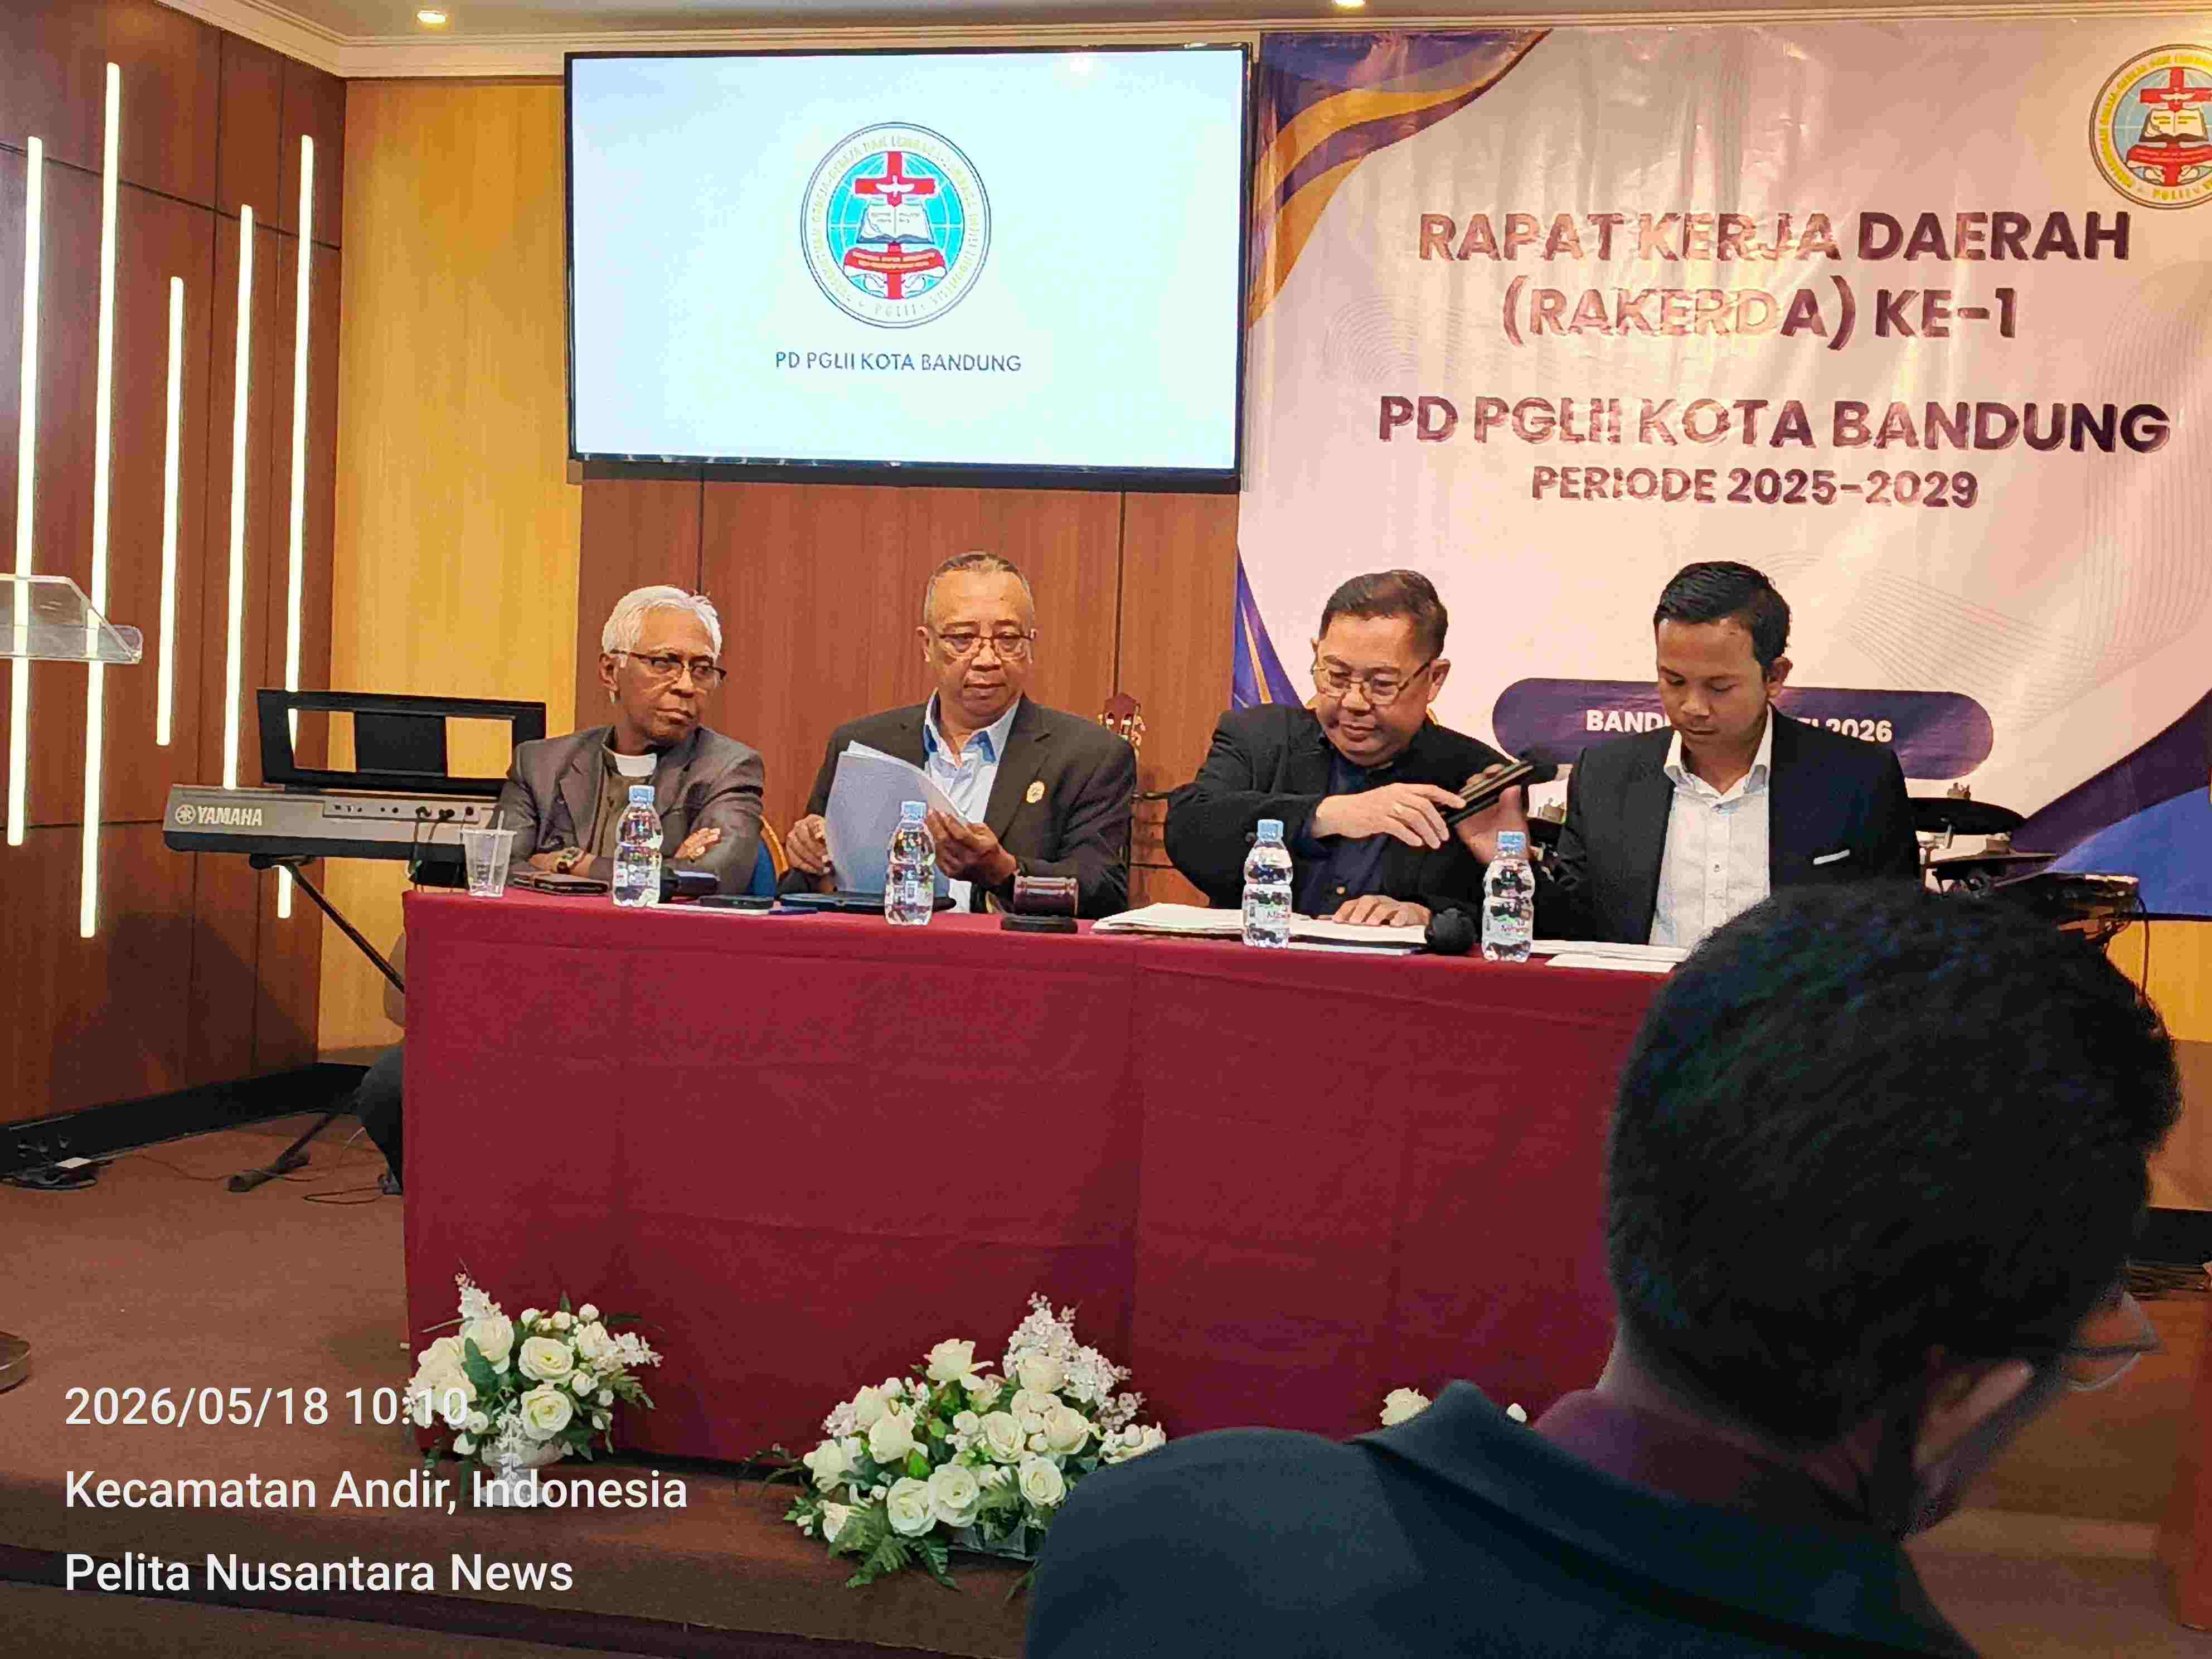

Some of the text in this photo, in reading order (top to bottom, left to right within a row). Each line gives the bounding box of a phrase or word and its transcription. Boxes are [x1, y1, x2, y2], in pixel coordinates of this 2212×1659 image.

[1419, 211, 2131, 261] RAPAT KERJA DAERAH
[1503, 275, 2017, 351] (RAKERDA) KE-1
[775, 351, 1022, 372] PD PGLII KOTA BANDUNG
[1379, 396, 2172, 454] PD PGLII KOTA BANDUNG
[1531, 466, 1979, 508] PERIODE 2025-2029
[197, 805, 263, 827] YAMAHA
